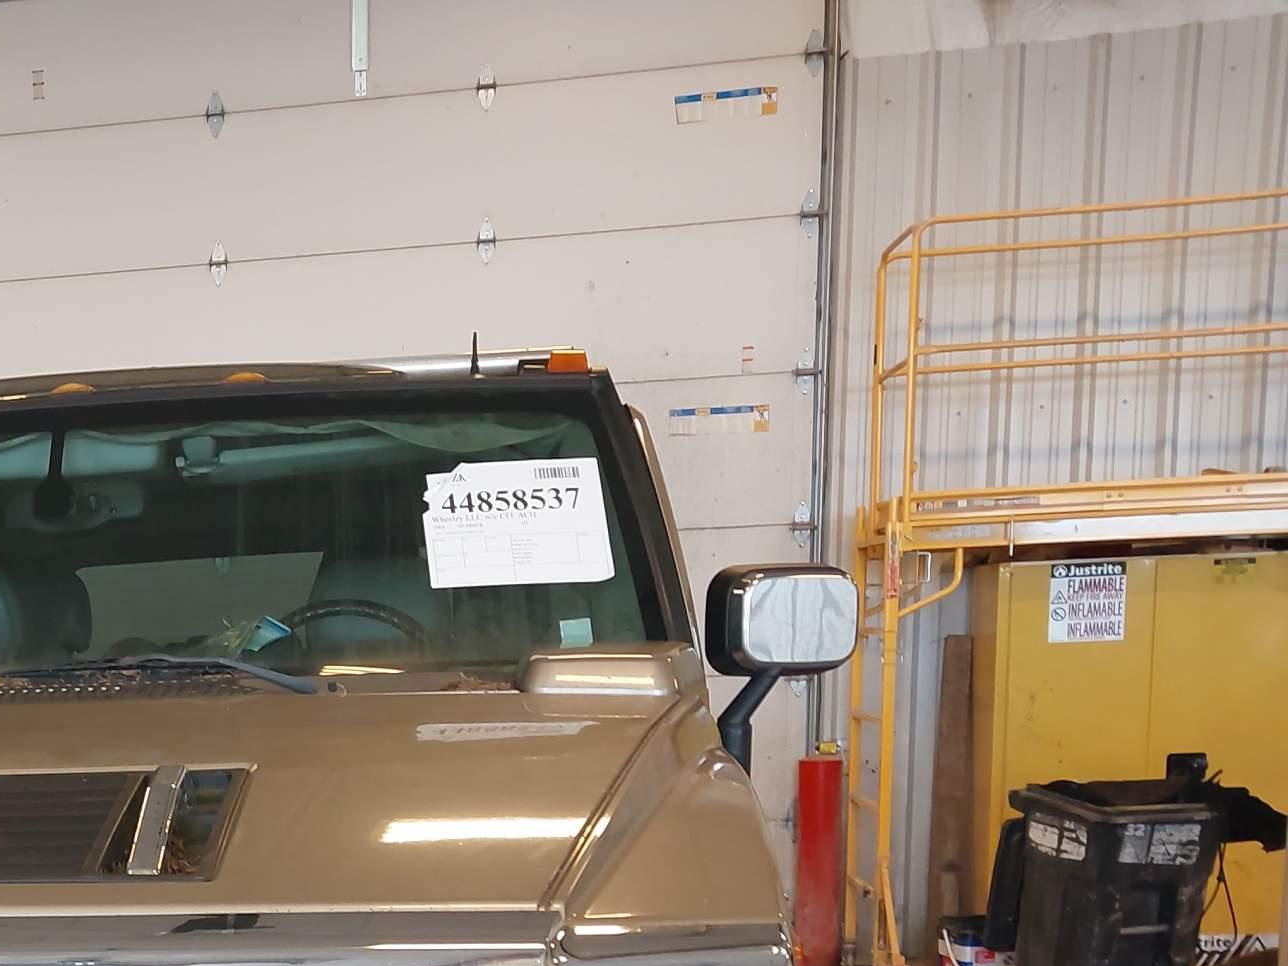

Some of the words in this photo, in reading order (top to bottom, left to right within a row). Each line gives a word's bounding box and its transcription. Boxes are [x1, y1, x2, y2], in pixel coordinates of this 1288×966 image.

[441, 487, 580, 514] 44858537
[1068, 564, 1123, 576] Justrite
[1067, 577, 1124, 593] FLAMMABLE
[1103, 592, 1123, 600] AWAY
[1068, 601, 1123, 617] INFLAMABLE
[1067, 620, 1122, 638] INFLAMMABLE
